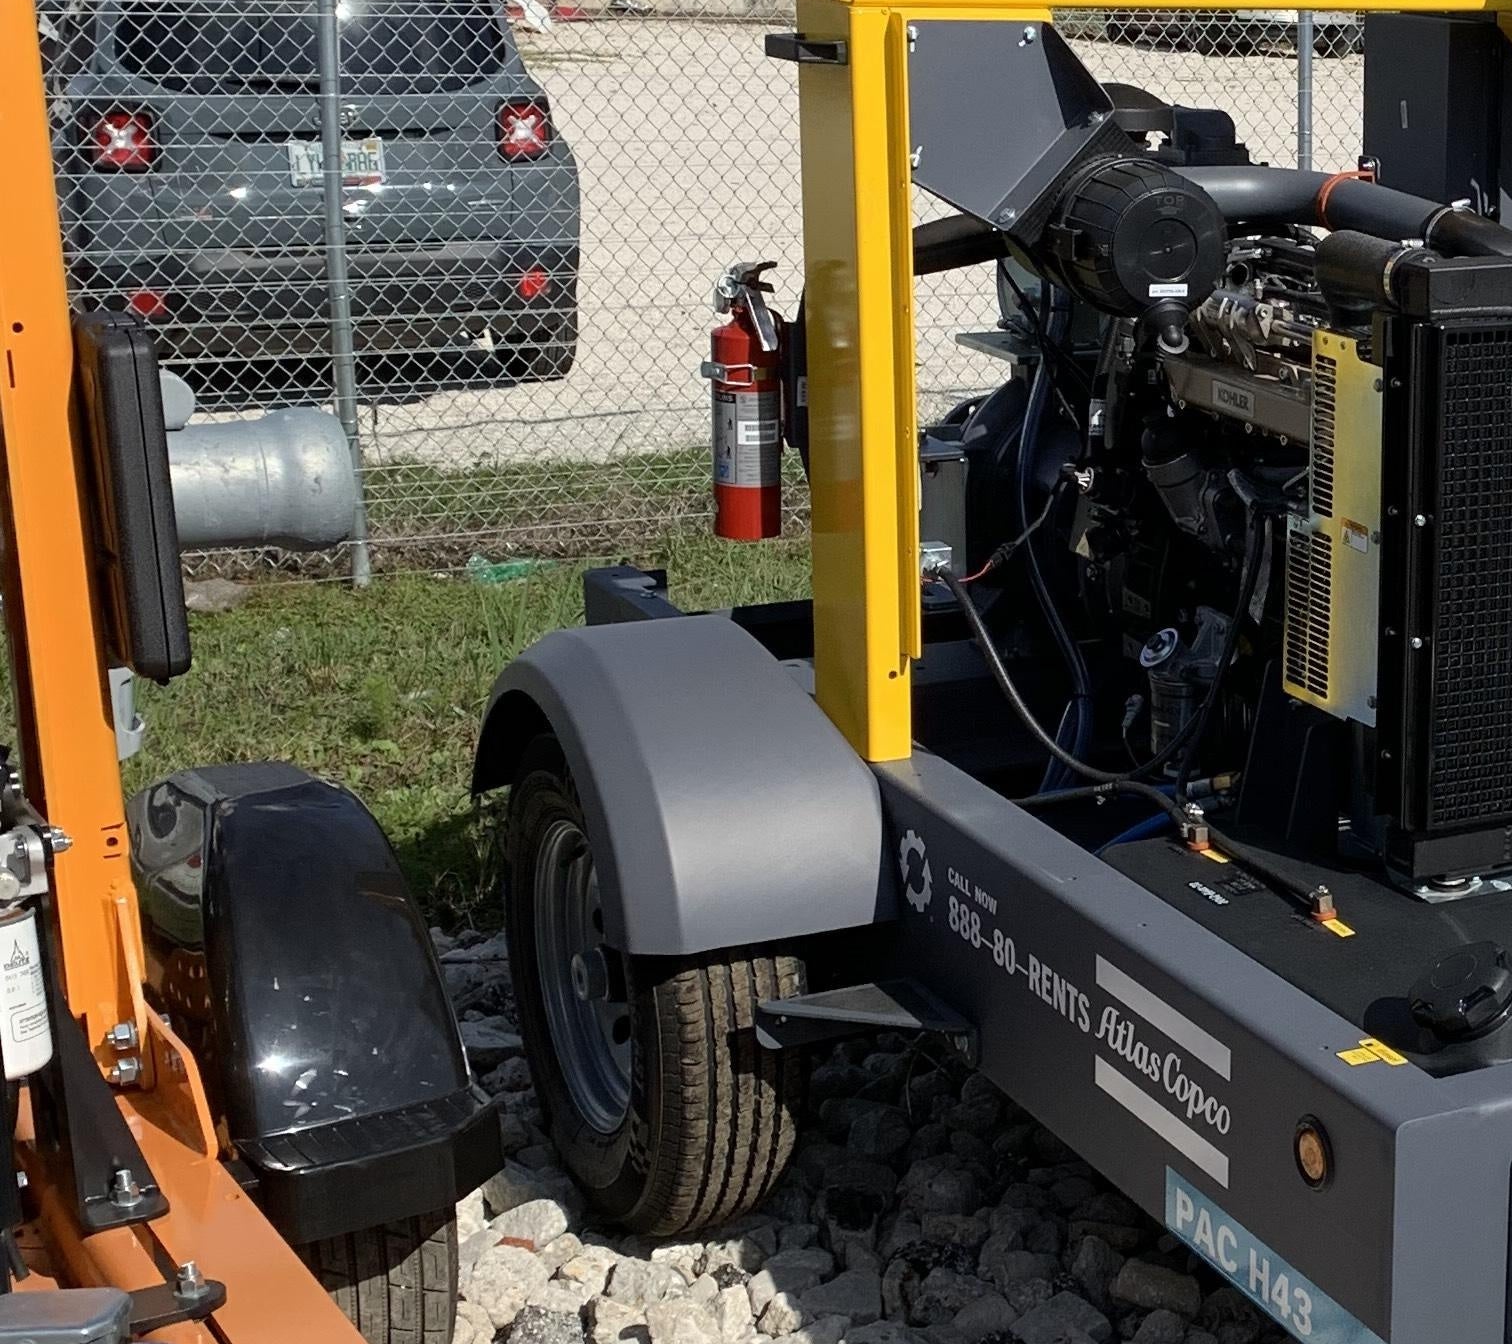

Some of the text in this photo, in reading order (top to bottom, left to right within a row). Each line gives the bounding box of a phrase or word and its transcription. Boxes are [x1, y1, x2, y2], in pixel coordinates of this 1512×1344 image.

[1217, 386, 1249, 411] KOHLER
[947, 867, 998, 915] CALL NOW
[949, 895, 1090, 1033] 888-80-RENTS
[1094, 1006, 1231, 1135] Atlas Copco
[1176, 1187, 1312, 1336] PAC H43
